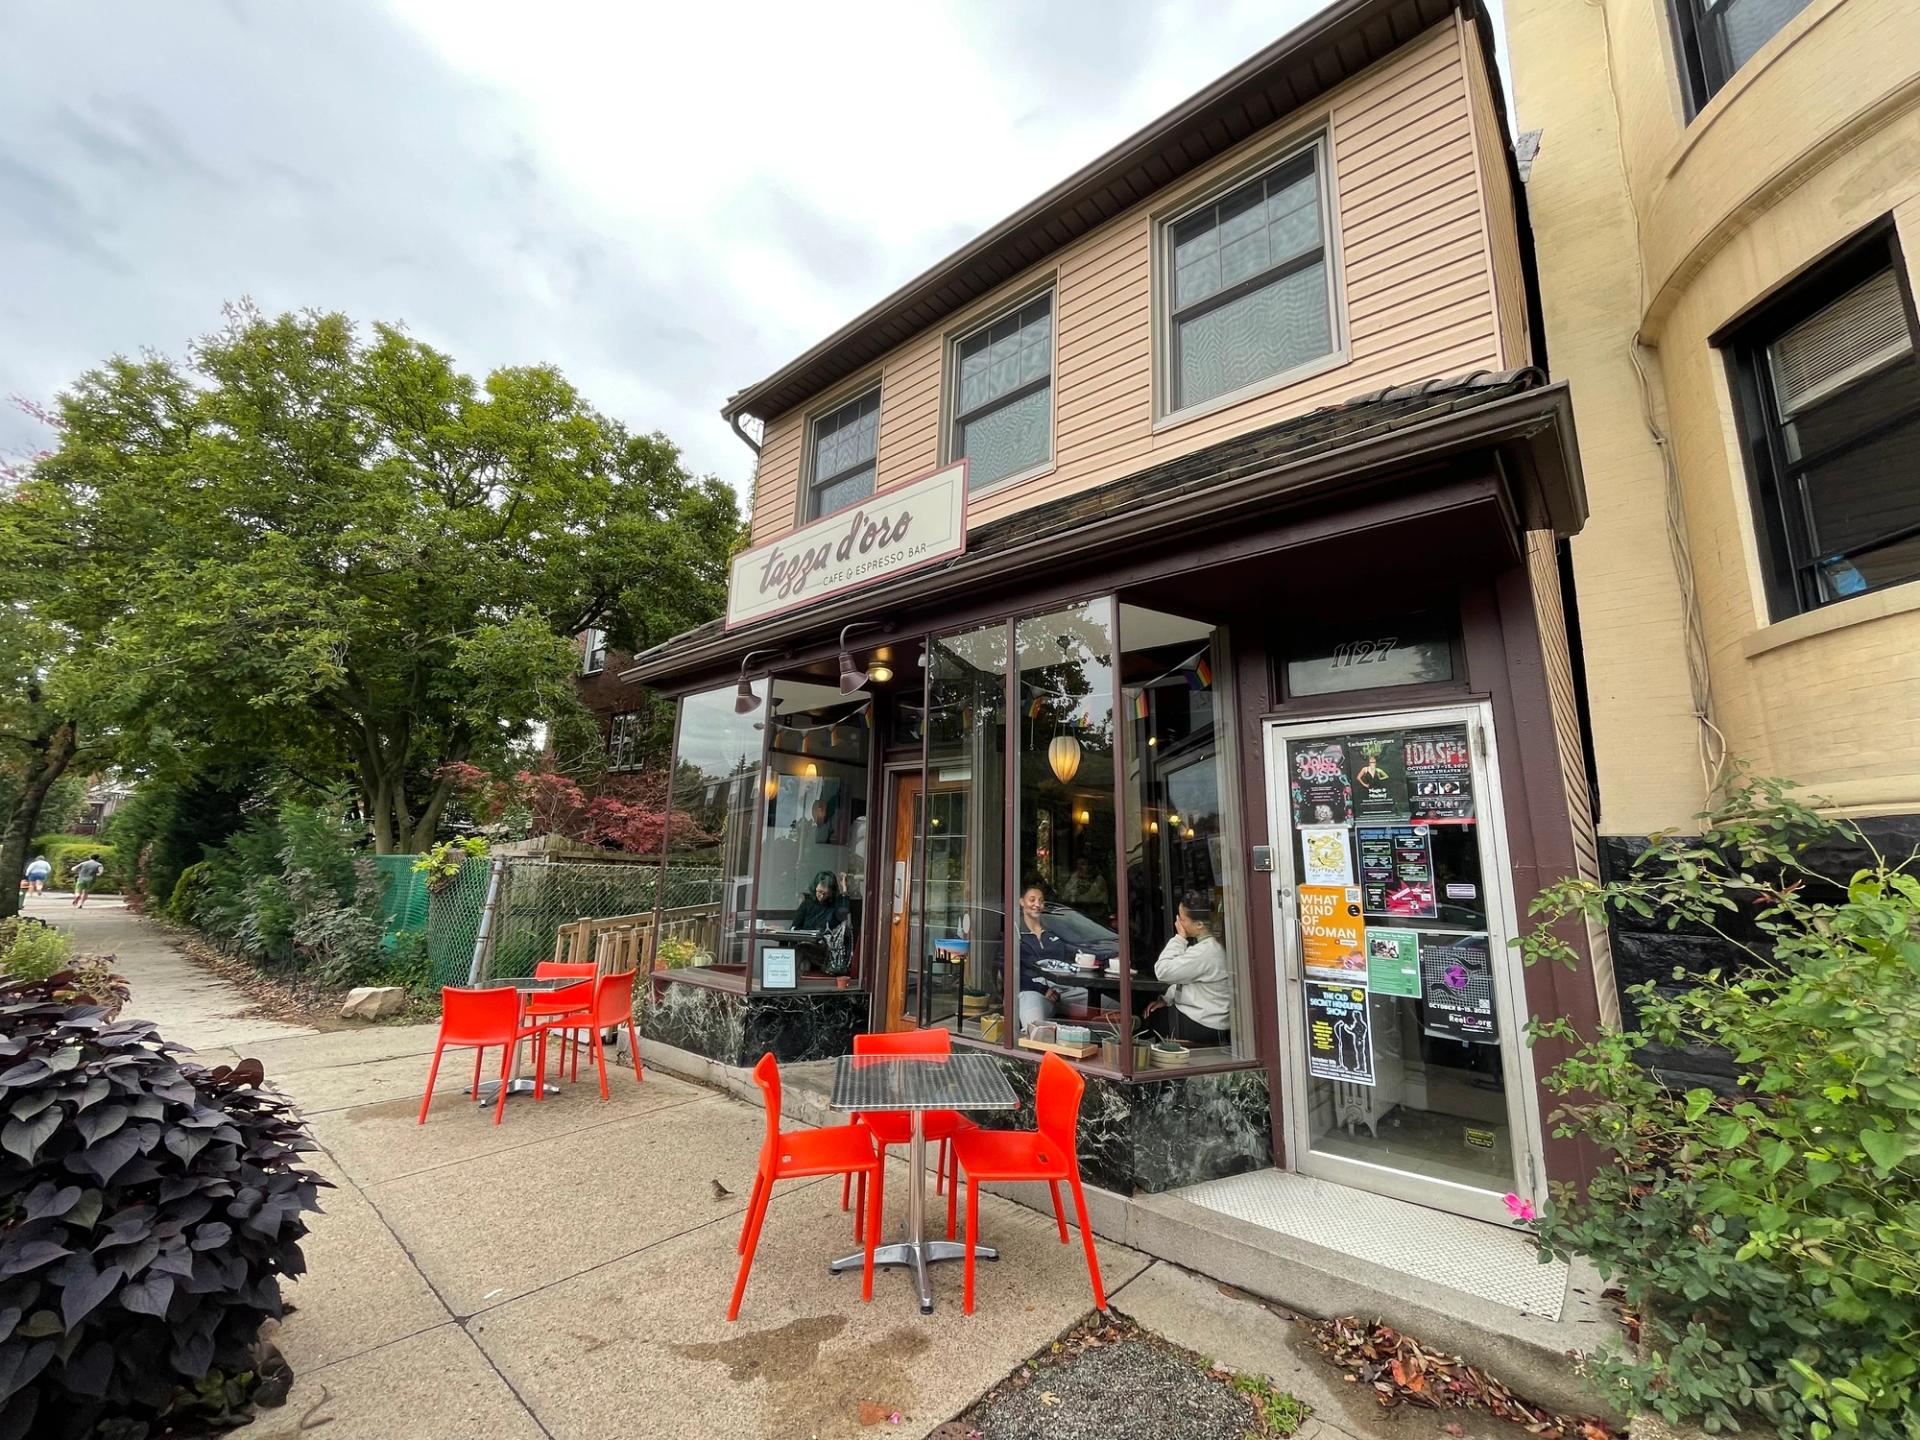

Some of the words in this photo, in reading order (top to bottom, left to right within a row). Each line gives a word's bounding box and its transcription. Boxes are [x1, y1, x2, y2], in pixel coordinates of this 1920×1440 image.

[760, 542, 832, 600] tazza
[837, 510, 914, 562] d'oro
[823, 571, 844, 586] CAFE
[855, 551, 904, 575] ESPRESSO
[908, 543, 926, 558] BAR
[1331, 637, 1399, 669] 1127
[1300, 894, 1339, 906] WHAT
[1301, 904, 1333, 916] KIND
[1301, 915, 1319, 925] OF
[1302, 926, 1356, 939] WOMAN
[1428, 1002, 1455, 1011] OCTOBER
